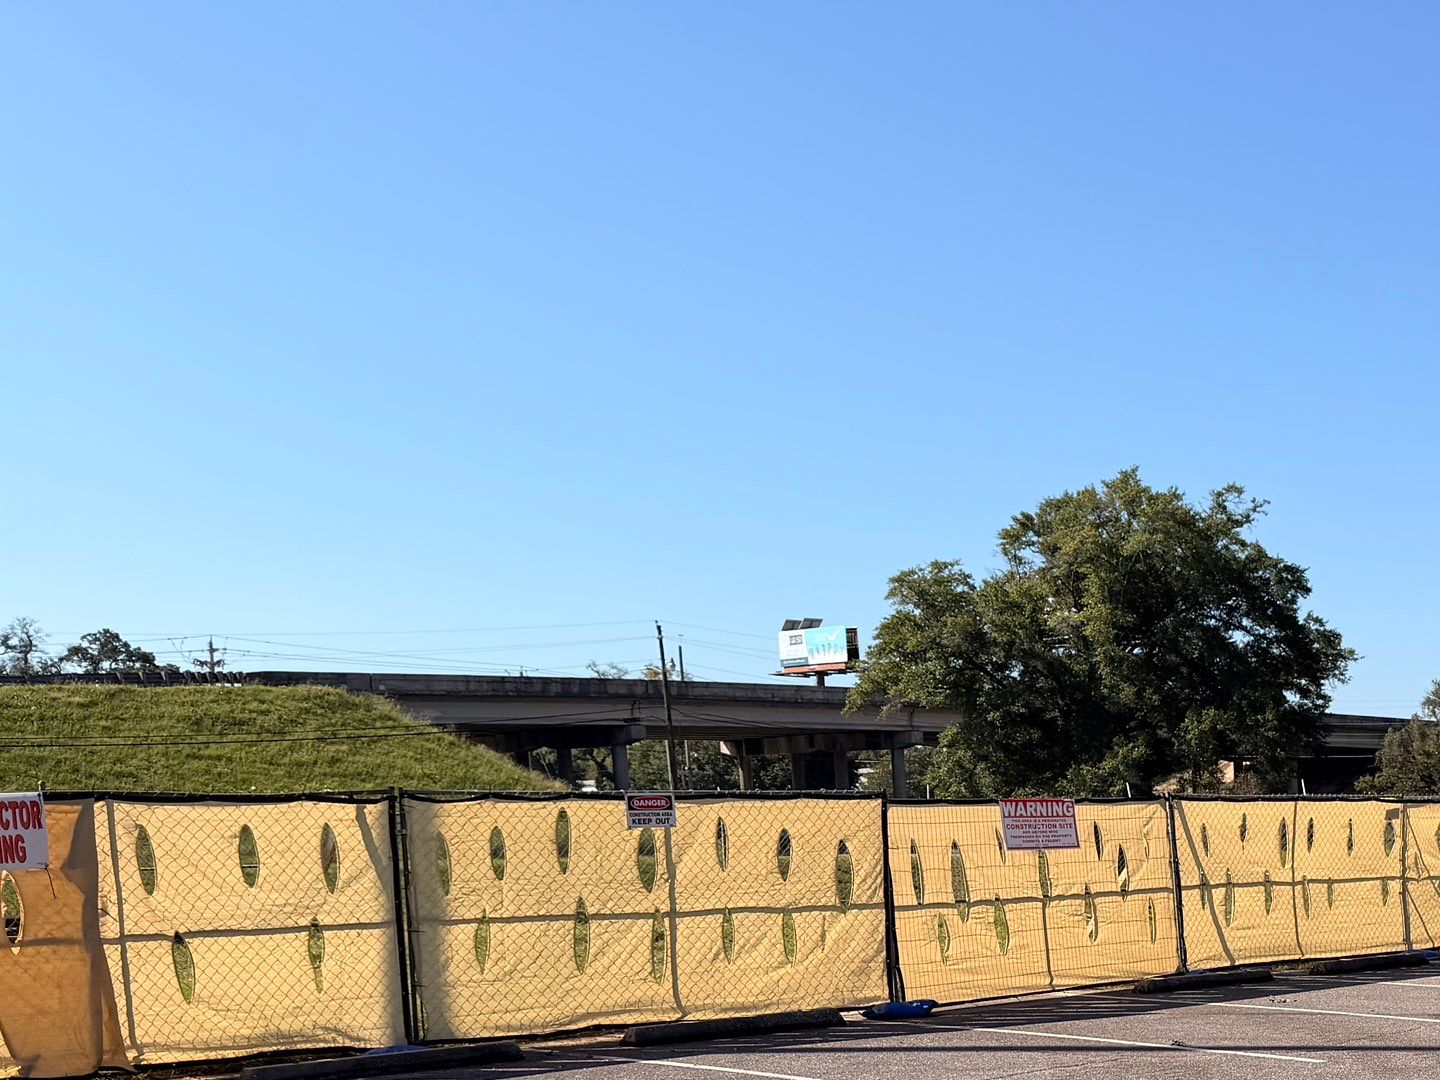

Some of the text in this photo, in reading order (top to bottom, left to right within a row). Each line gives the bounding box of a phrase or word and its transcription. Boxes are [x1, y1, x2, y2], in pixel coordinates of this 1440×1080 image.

[633, 799, 667, 807] DANGER
[1002, 801, 1074, 817] WARNING
[655, 817, 671, 825] OUT
